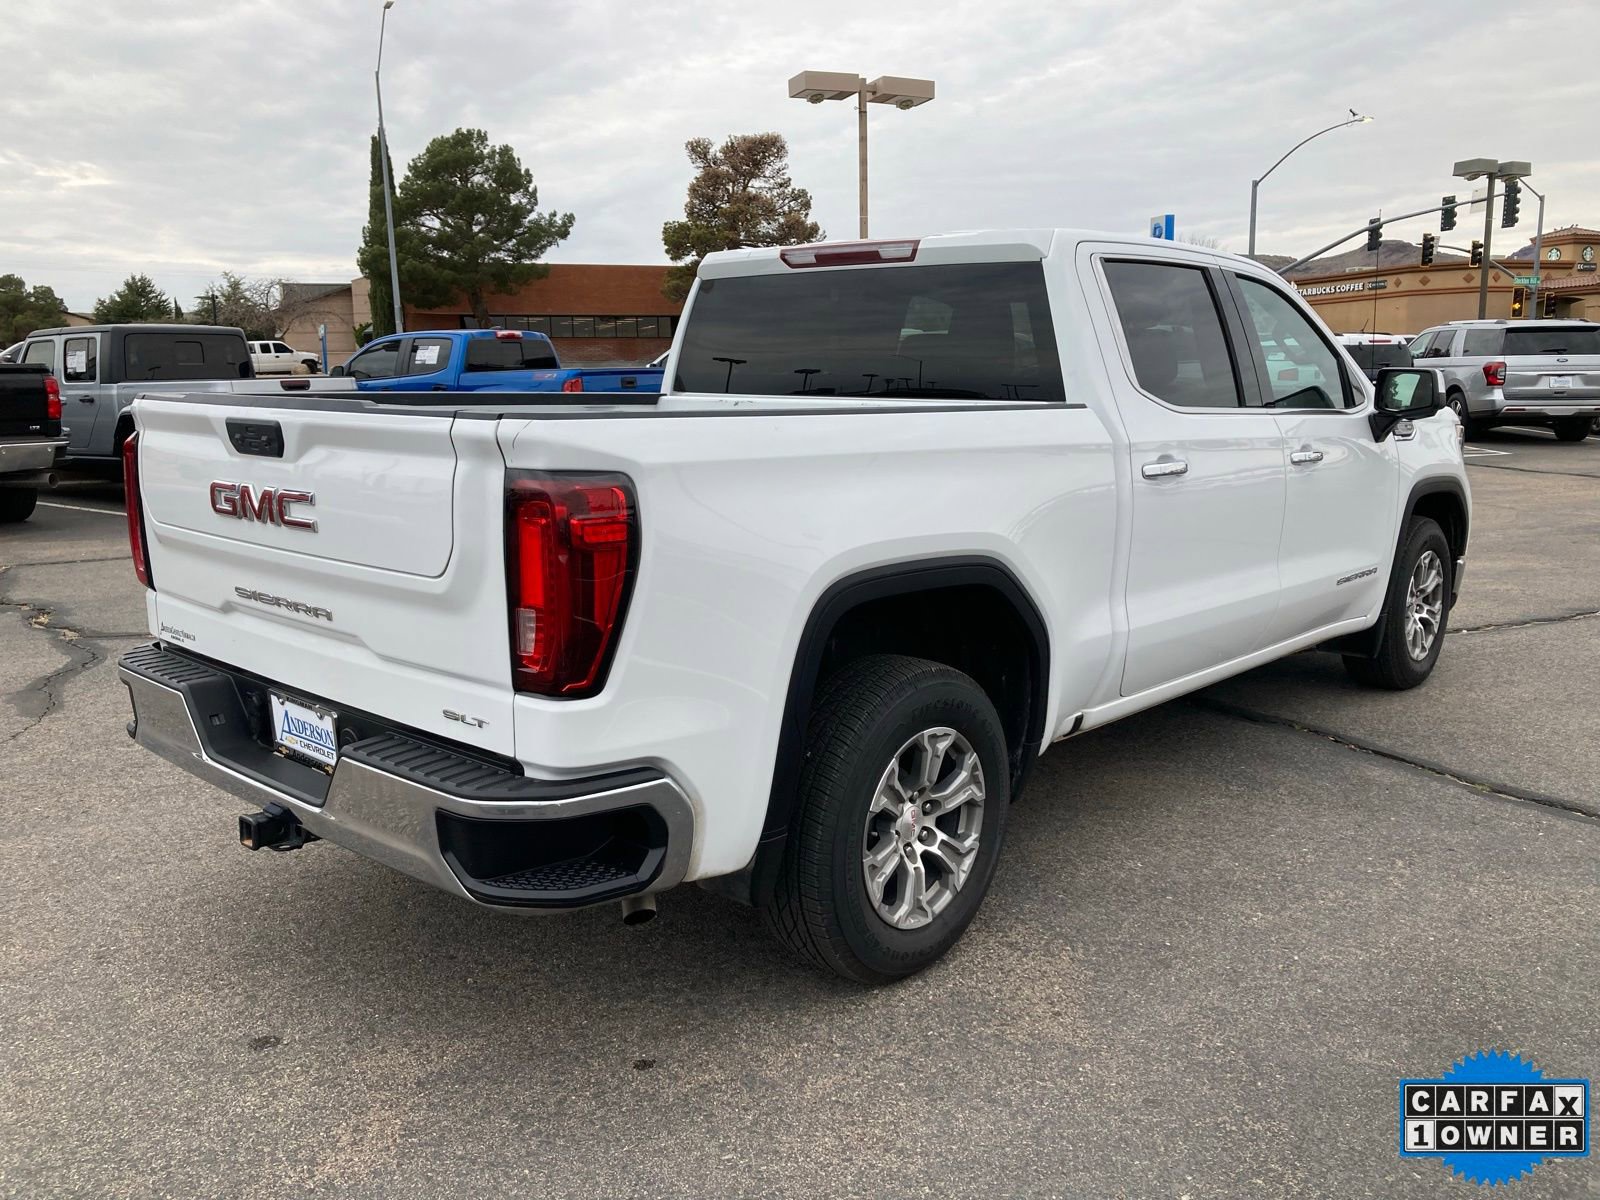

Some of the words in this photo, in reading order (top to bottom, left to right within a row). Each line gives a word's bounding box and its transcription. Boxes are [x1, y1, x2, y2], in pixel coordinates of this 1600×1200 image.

[1336, 282, 1364, 292] COFFEE
[210, 480, 319, 533] GMC
[1336, 567, 1378, 586] SIERRA
[234, 586, 334, 621] SIERRA
[279, 709, 335, 747] ANDERSON
[442, 709, 490, 729] SLT
[299, 741, 335, 760] CHEVROLET
